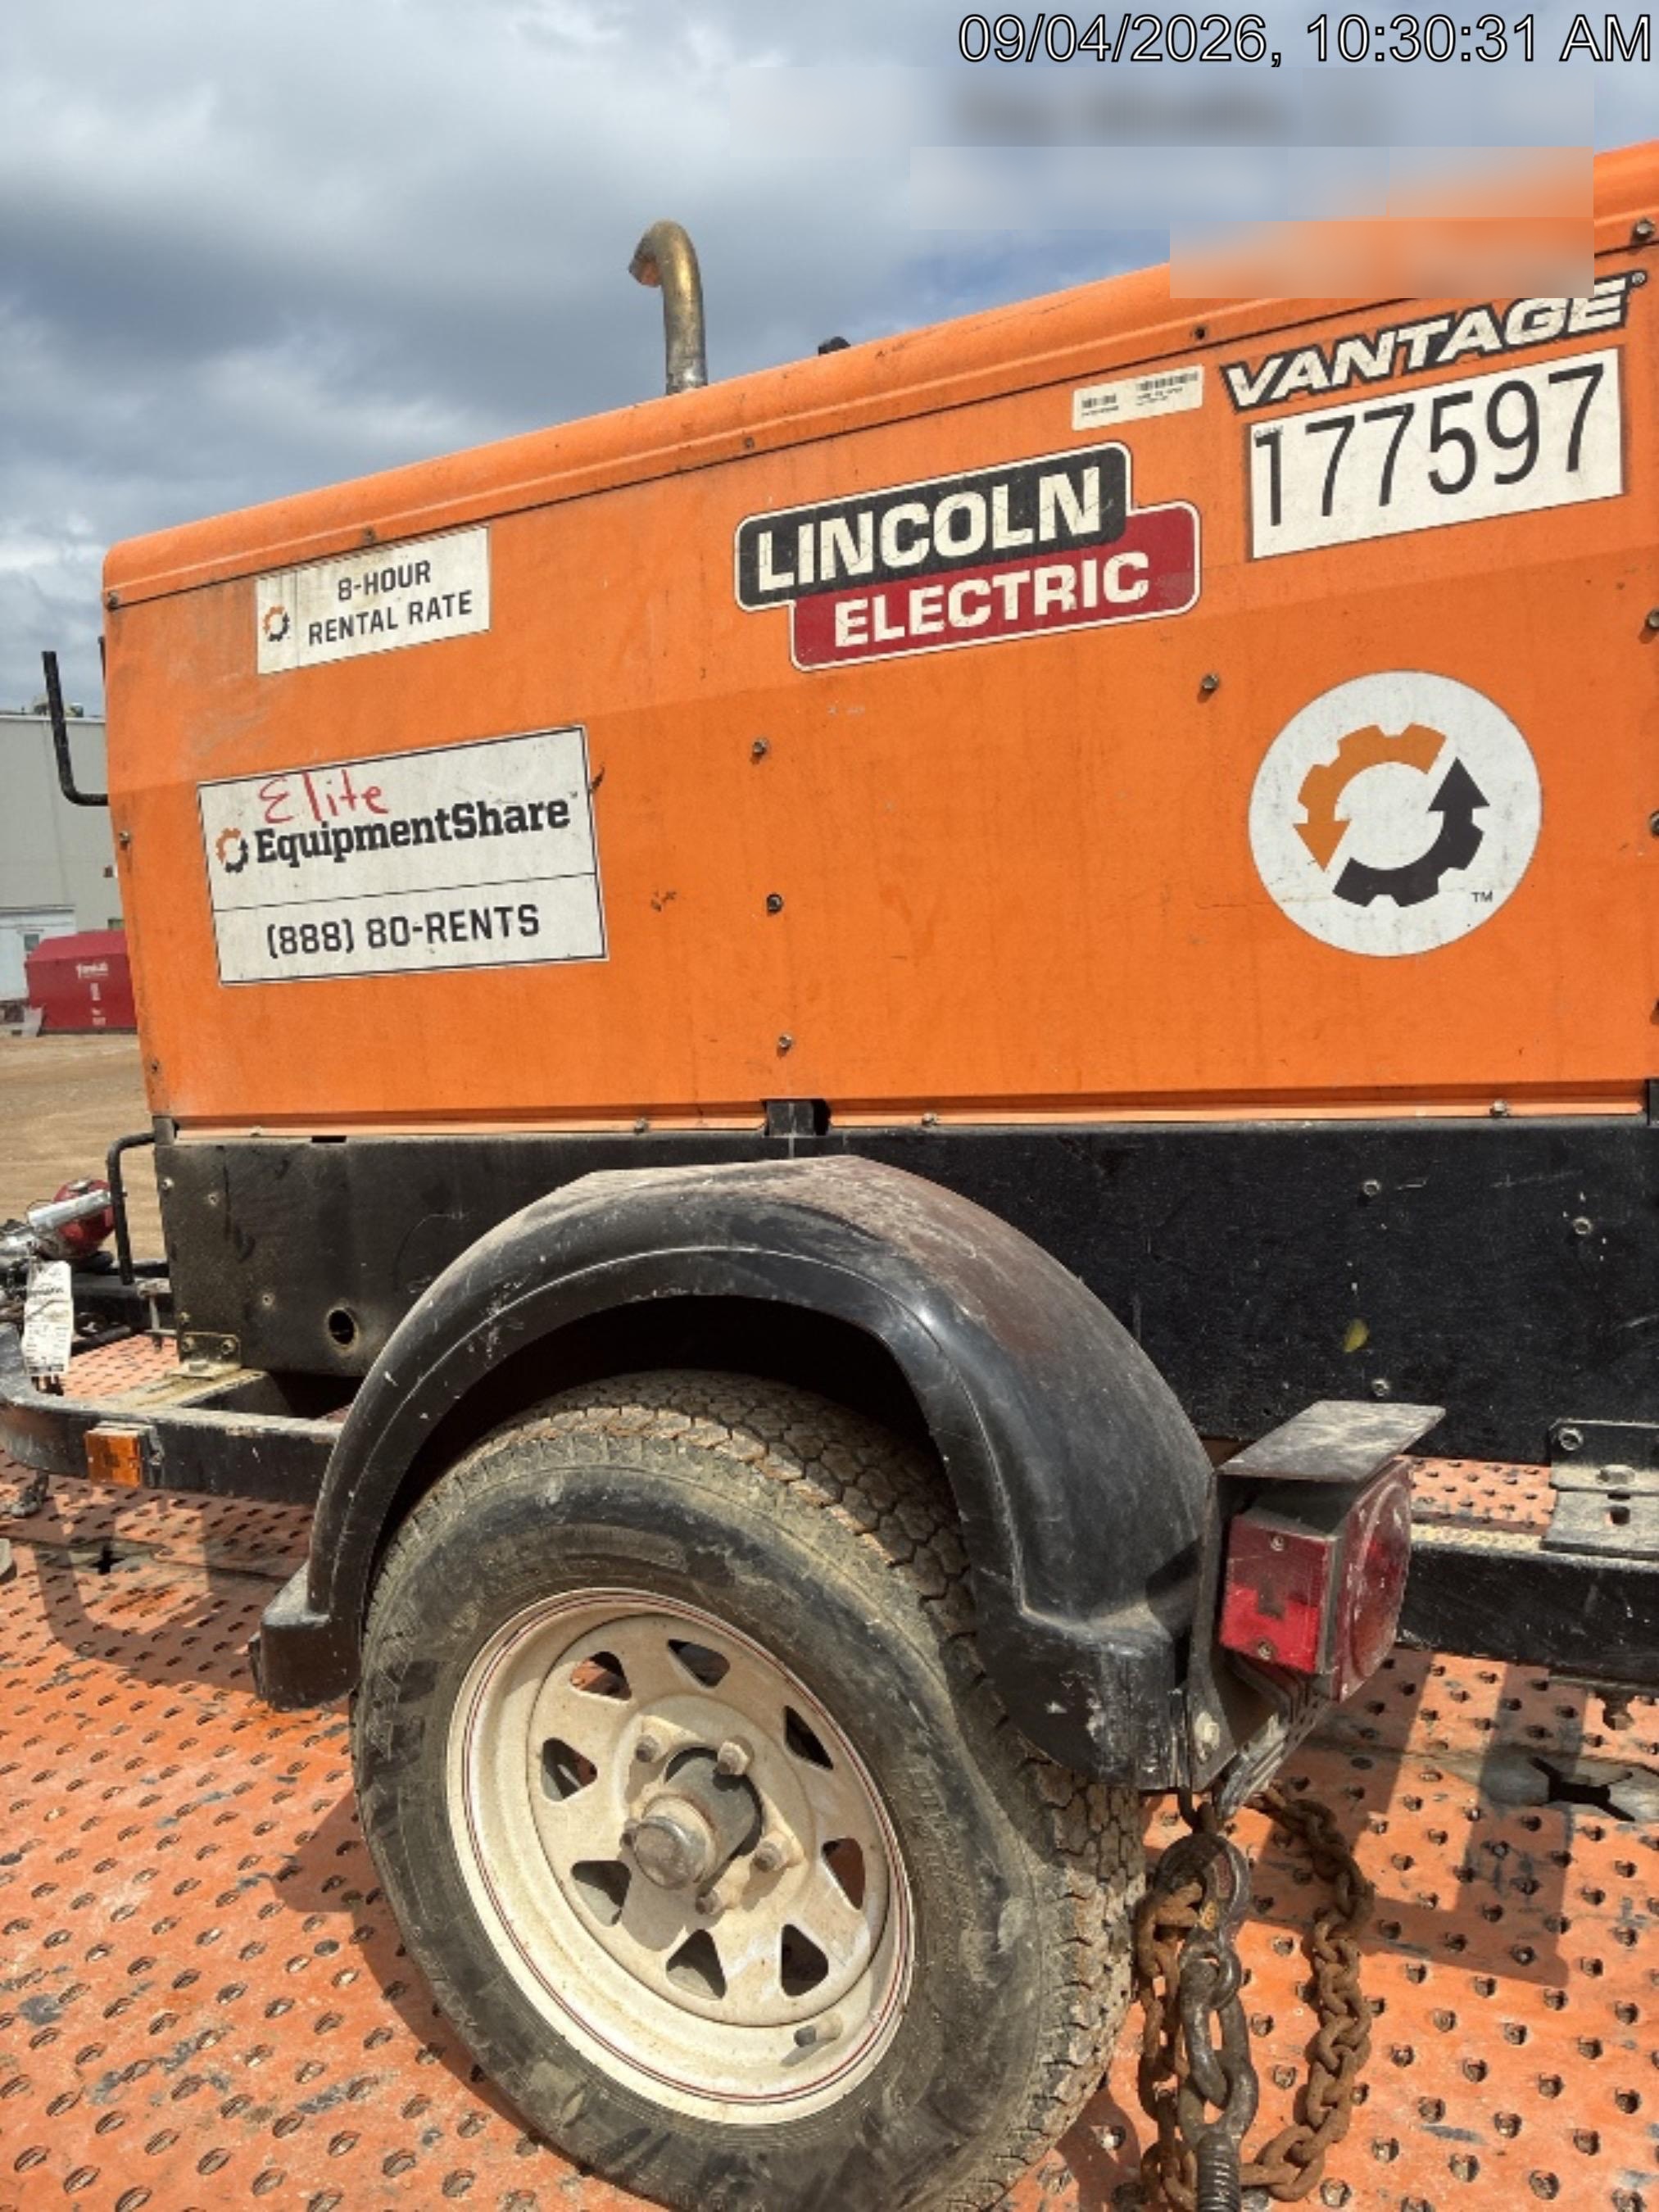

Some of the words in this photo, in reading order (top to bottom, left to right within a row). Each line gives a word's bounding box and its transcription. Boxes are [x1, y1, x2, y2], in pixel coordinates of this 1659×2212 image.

[1225, 275, 1627, 408] VANTAGE
[1254, 362, 1606, 526] 177597
[757, 465, 1102, 593] LINCOLN
[337, 559, 432, 602] 8-HOUR
[834, 551, 1149, 648] ELECTRIC
[308, 605, 399, 646] RENTAL
[409, 589, 473, 625] RATE
[254, 798, 571, 868] EquipmentShare
[266, 918, 355, 959] (888)
[366, 903, 540, 949] 80-RENTS
[1470, 889, 1494, 903] TM
